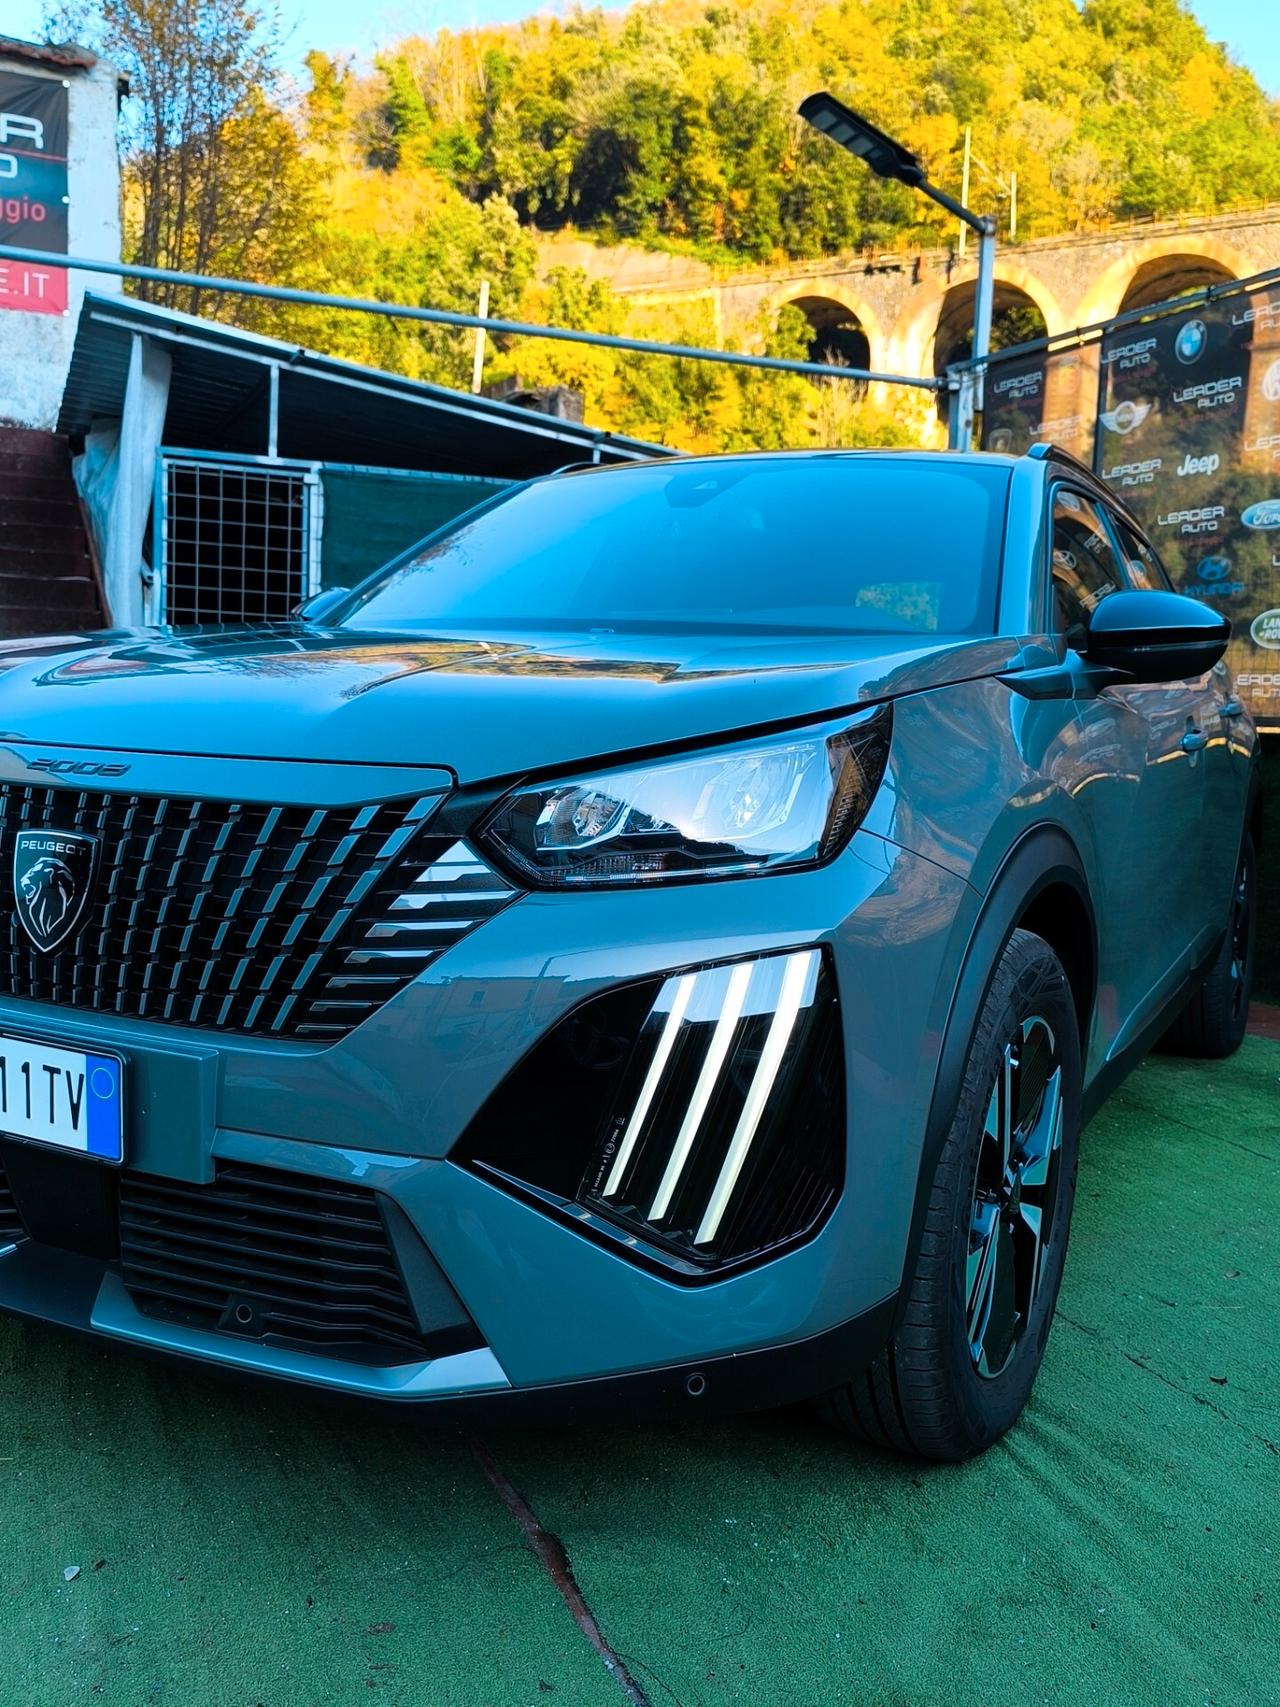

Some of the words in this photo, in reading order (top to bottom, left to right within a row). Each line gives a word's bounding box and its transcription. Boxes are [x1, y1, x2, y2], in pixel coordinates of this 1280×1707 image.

[0, 195, 46, 225] gio
[1101, 338, 1157, 364] LEADER
[1120, 353, 1151, 369] AUTO
[993, 371, 1042, 394] LEADER
[1173, 376, 1242, 403] LEADER
[1197, 392, 1235, 409] AUTO
[1102, 458, 1162, 480] LEADER
[1177, 453, 1220, 476] Jeep
[1122, 472, 1154, 486] AUTO
[1158, 505, 1225, 526] LEADER
[1181, 521, 1218, 534] AUTO
[27, 758, 132, 777] 2008
[20, 840, 86, 856] PEUGEOT
